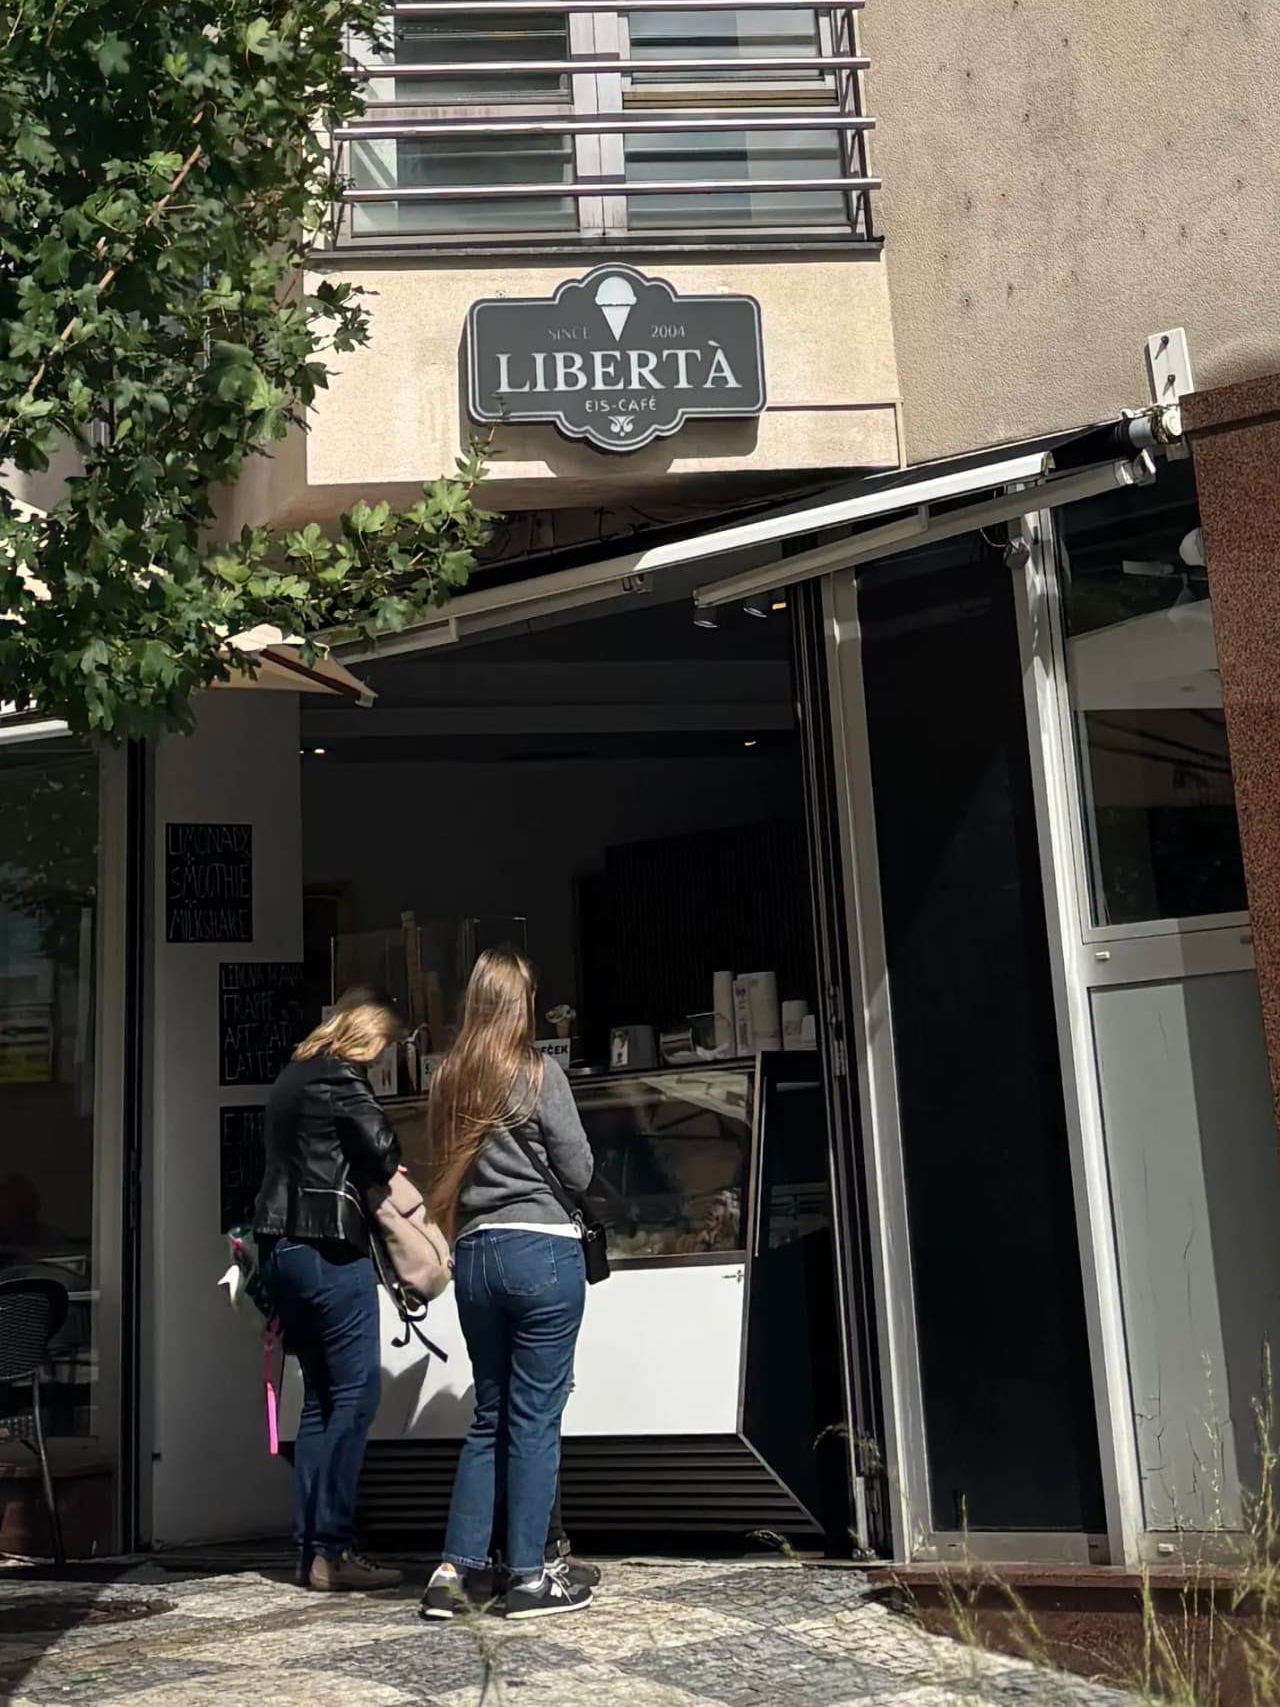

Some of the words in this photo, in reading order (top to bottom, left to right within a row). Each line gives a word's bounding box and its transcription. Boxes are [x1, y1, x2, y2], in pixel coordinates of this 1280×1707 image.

[651, 325, 686, 338] 2004
[496, 340, 742, 394] LIBERTÀ
[585, 395, 657, 413] EIS-CAFÉ
